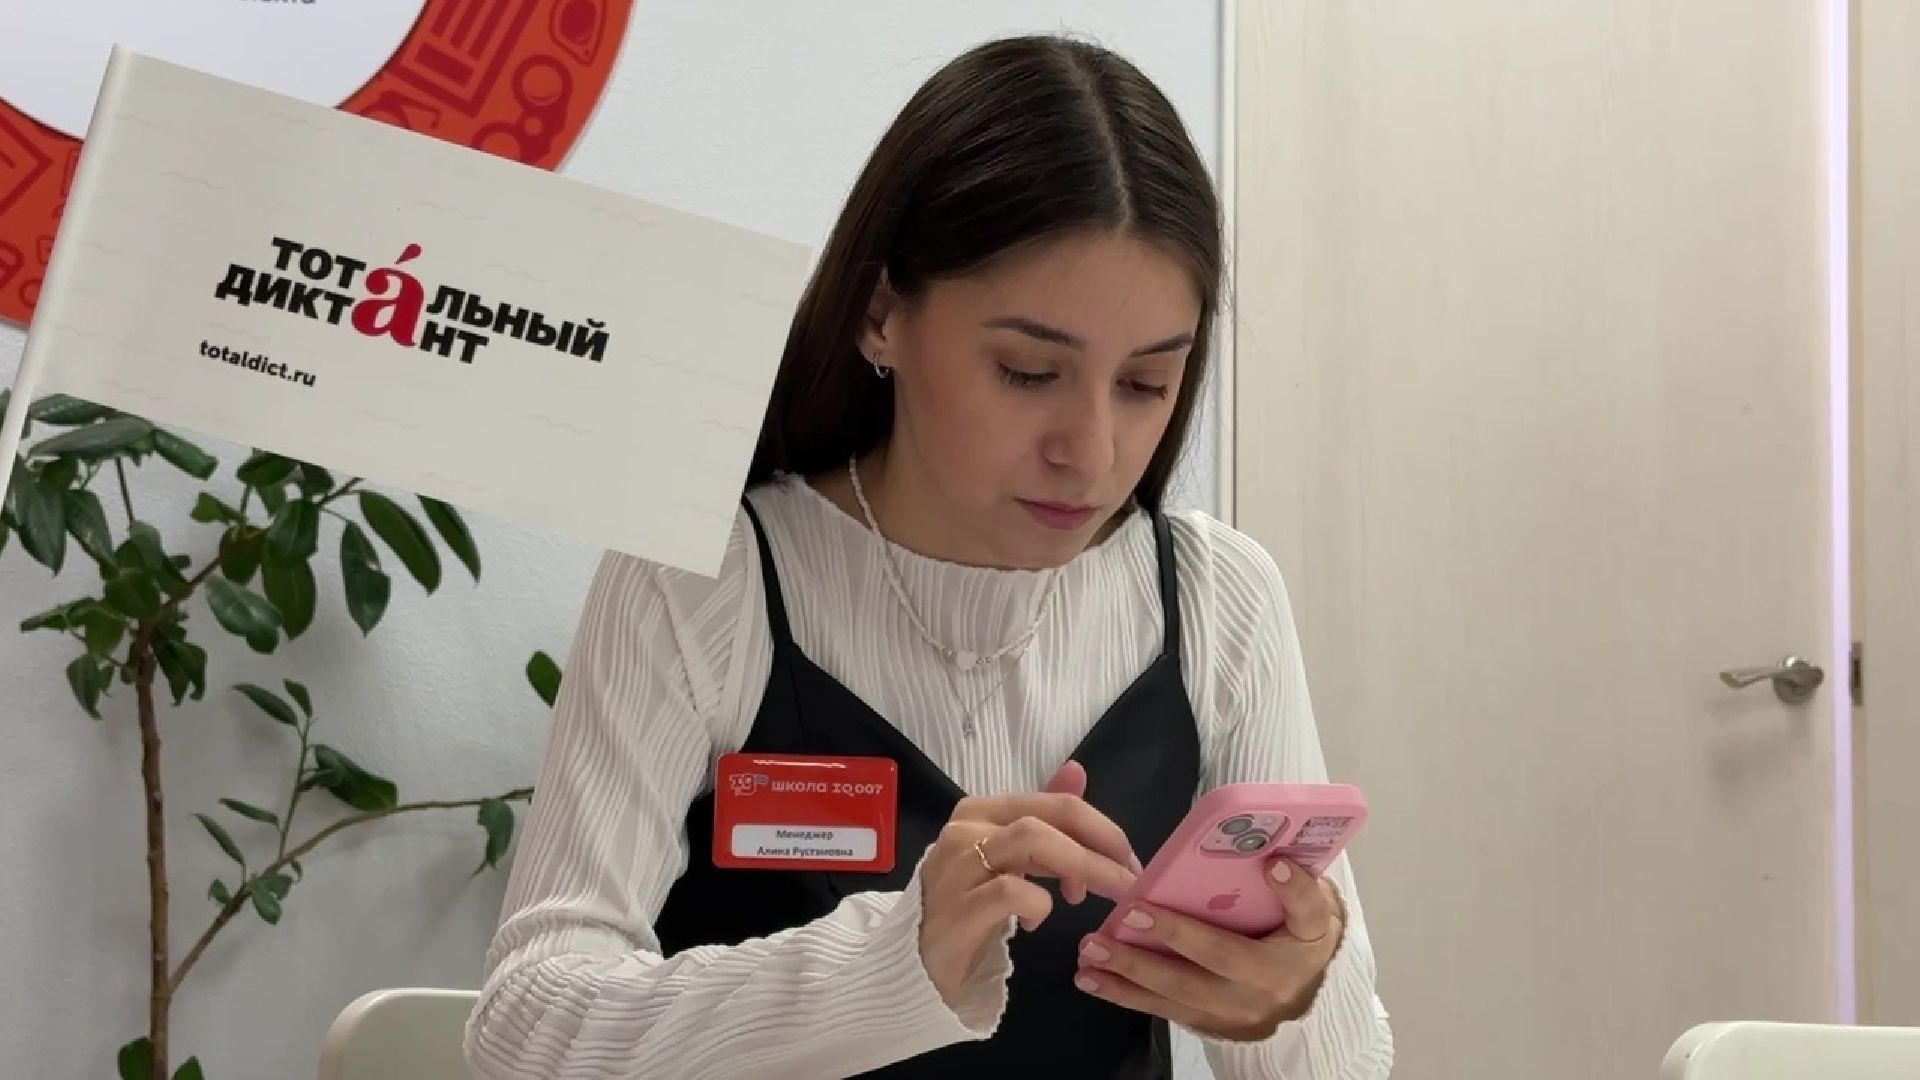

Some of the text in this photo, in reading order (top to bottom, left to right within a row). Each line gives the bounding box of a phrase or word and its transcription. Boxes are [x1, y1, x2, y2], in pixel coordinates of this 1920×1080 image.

[199, 339, 316, 387] totaldict.ru
[776, 830, 834, 840] Менеджер
[757, 846, 853, 857] Алина Рустамовна
